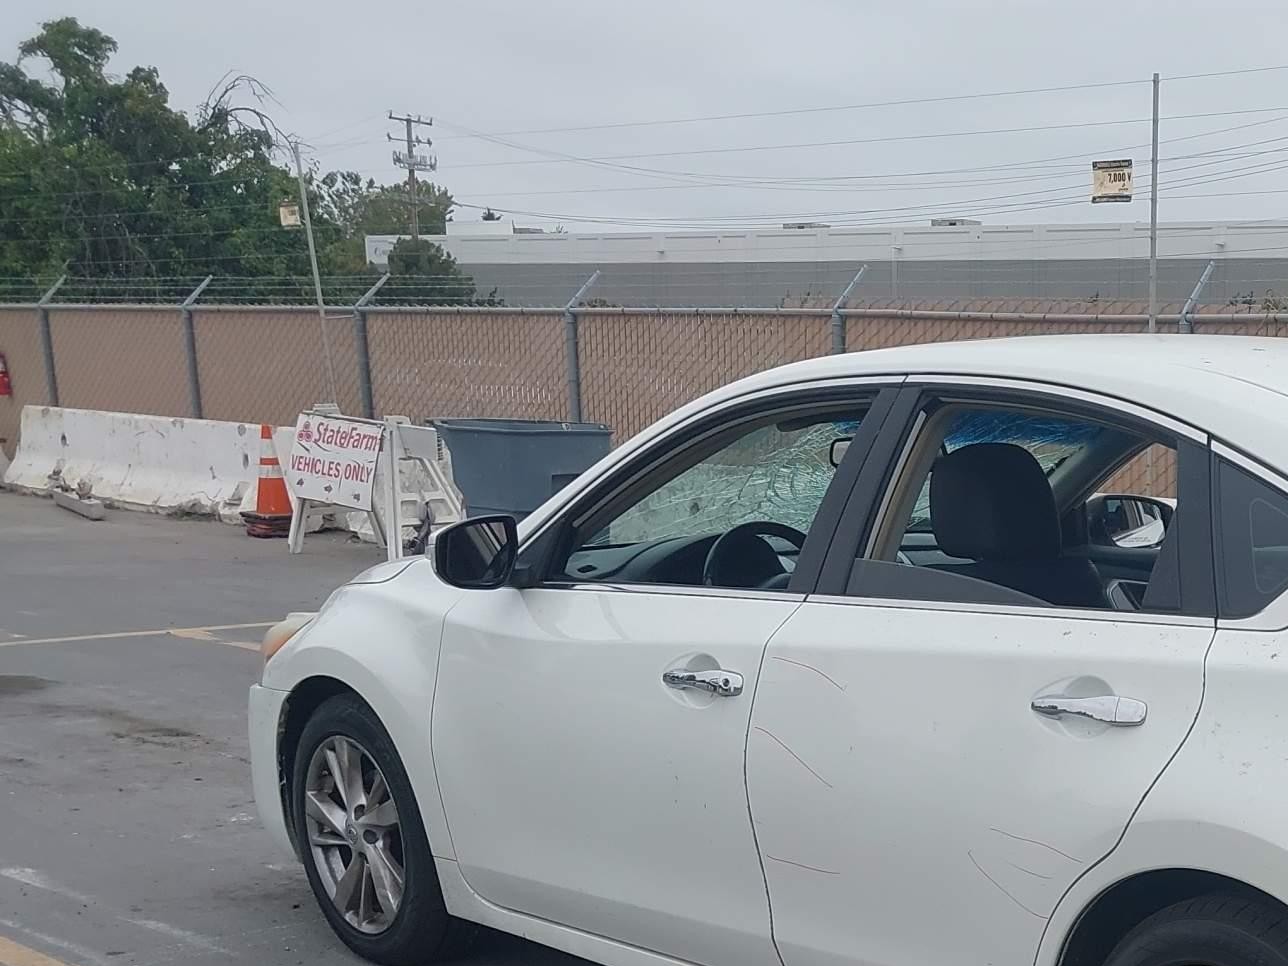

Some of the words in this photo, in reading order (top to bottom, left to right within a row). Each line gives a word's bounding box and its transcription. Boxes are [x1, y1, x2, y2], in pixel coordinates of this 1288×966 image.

[1107, 172, 1126, 184] 7,000
[291, 454, 341, 479] VEHICLES
[344, 463, 373, 484] ONLY
